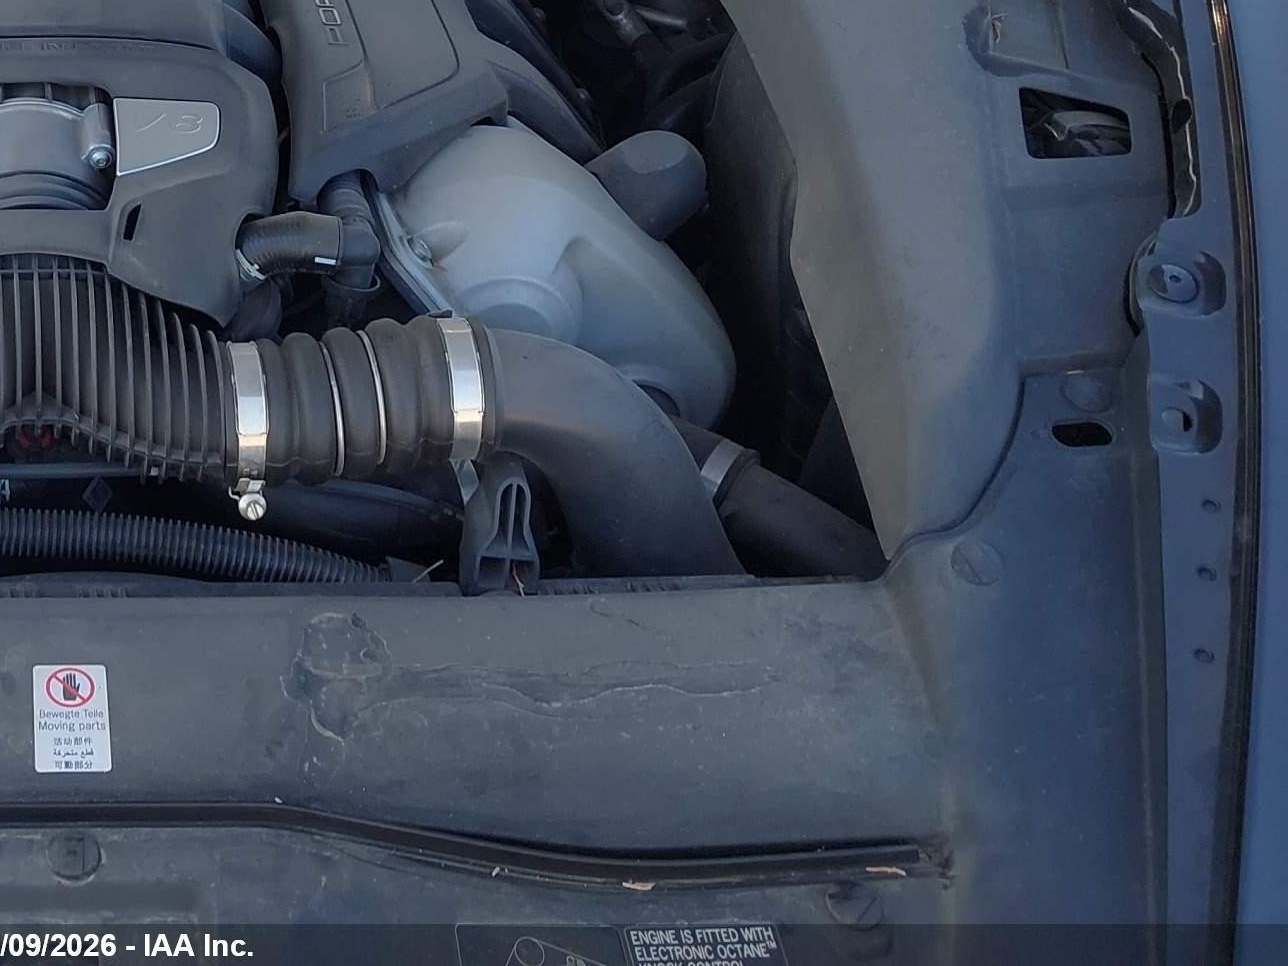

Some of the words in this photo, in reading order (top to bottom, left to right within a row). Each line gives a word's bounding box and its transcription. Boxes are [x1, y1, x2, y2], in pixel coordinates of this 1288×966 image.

[39, 709, 80, 720] Bewegte
[84, 709, 104, 719] Teile
[38, 721, 75, 732] Moving
[79, 721, 106, 731] parts
[630, 930, 679, 945] ENGINE
[680, 929, 694, 944] IS
[695, 927, 739, 944] FITTED
[740, 926, 774, 943] WITH
[634, 946, 714, 961] ELECTRONIC
